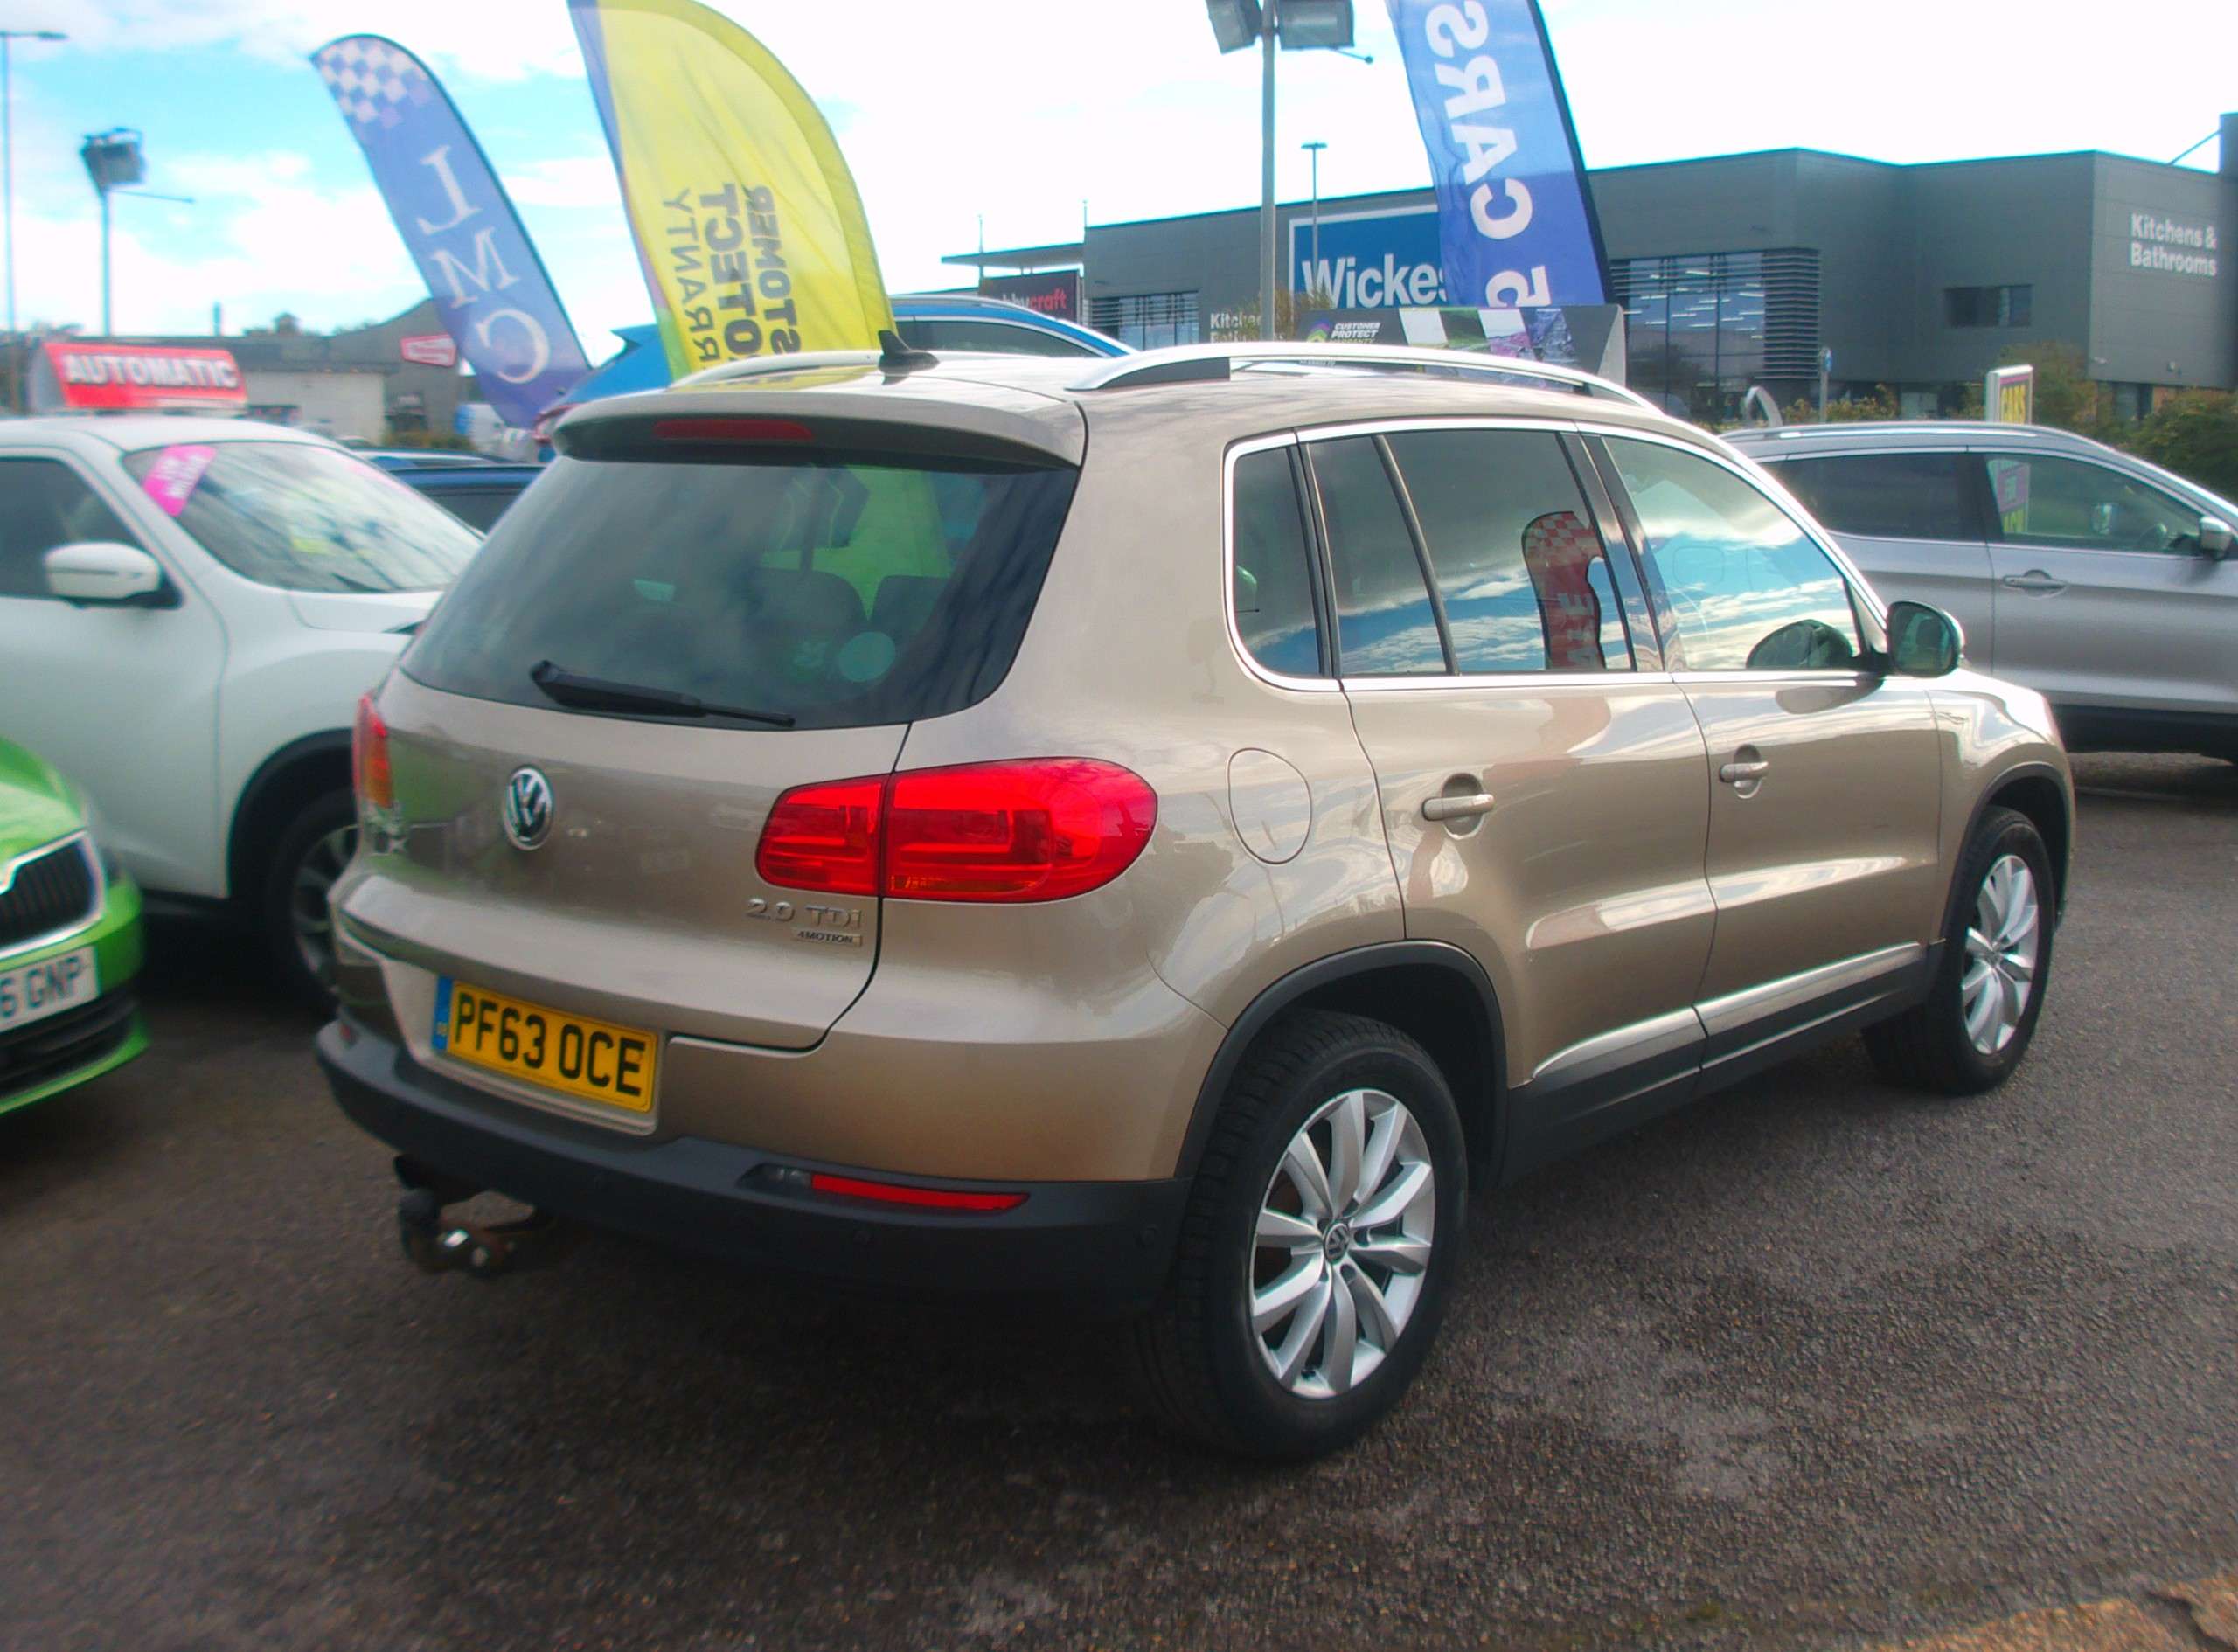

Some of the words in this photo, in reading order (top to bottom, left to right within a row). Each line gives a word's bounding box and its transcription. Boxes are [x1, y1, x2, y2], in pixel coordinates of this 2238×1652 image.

[2131, 213, 2203, 247] Kitchens
[2206, 226, 2218, 249] &
[2131, 242, 2218, 276] Bathrooms
[1302, 253, 1448, 309] Wicke
[1002, 287, 1067, 311] bycraft
[1210, 311, 1262, 329] Kitche
[1331, 330, 1379, 339] PROTECT
[1334, 322, 1381, 330] CUSTOMER
[63, 354, 240, 389] AUTOMATIC
[797, 930, 854, 944] 4MOTION
[25, 955, 80, 1009] GNP
[455, 991, 546, 1069] PF63
[559, 1023, 646, 1097] OCE
